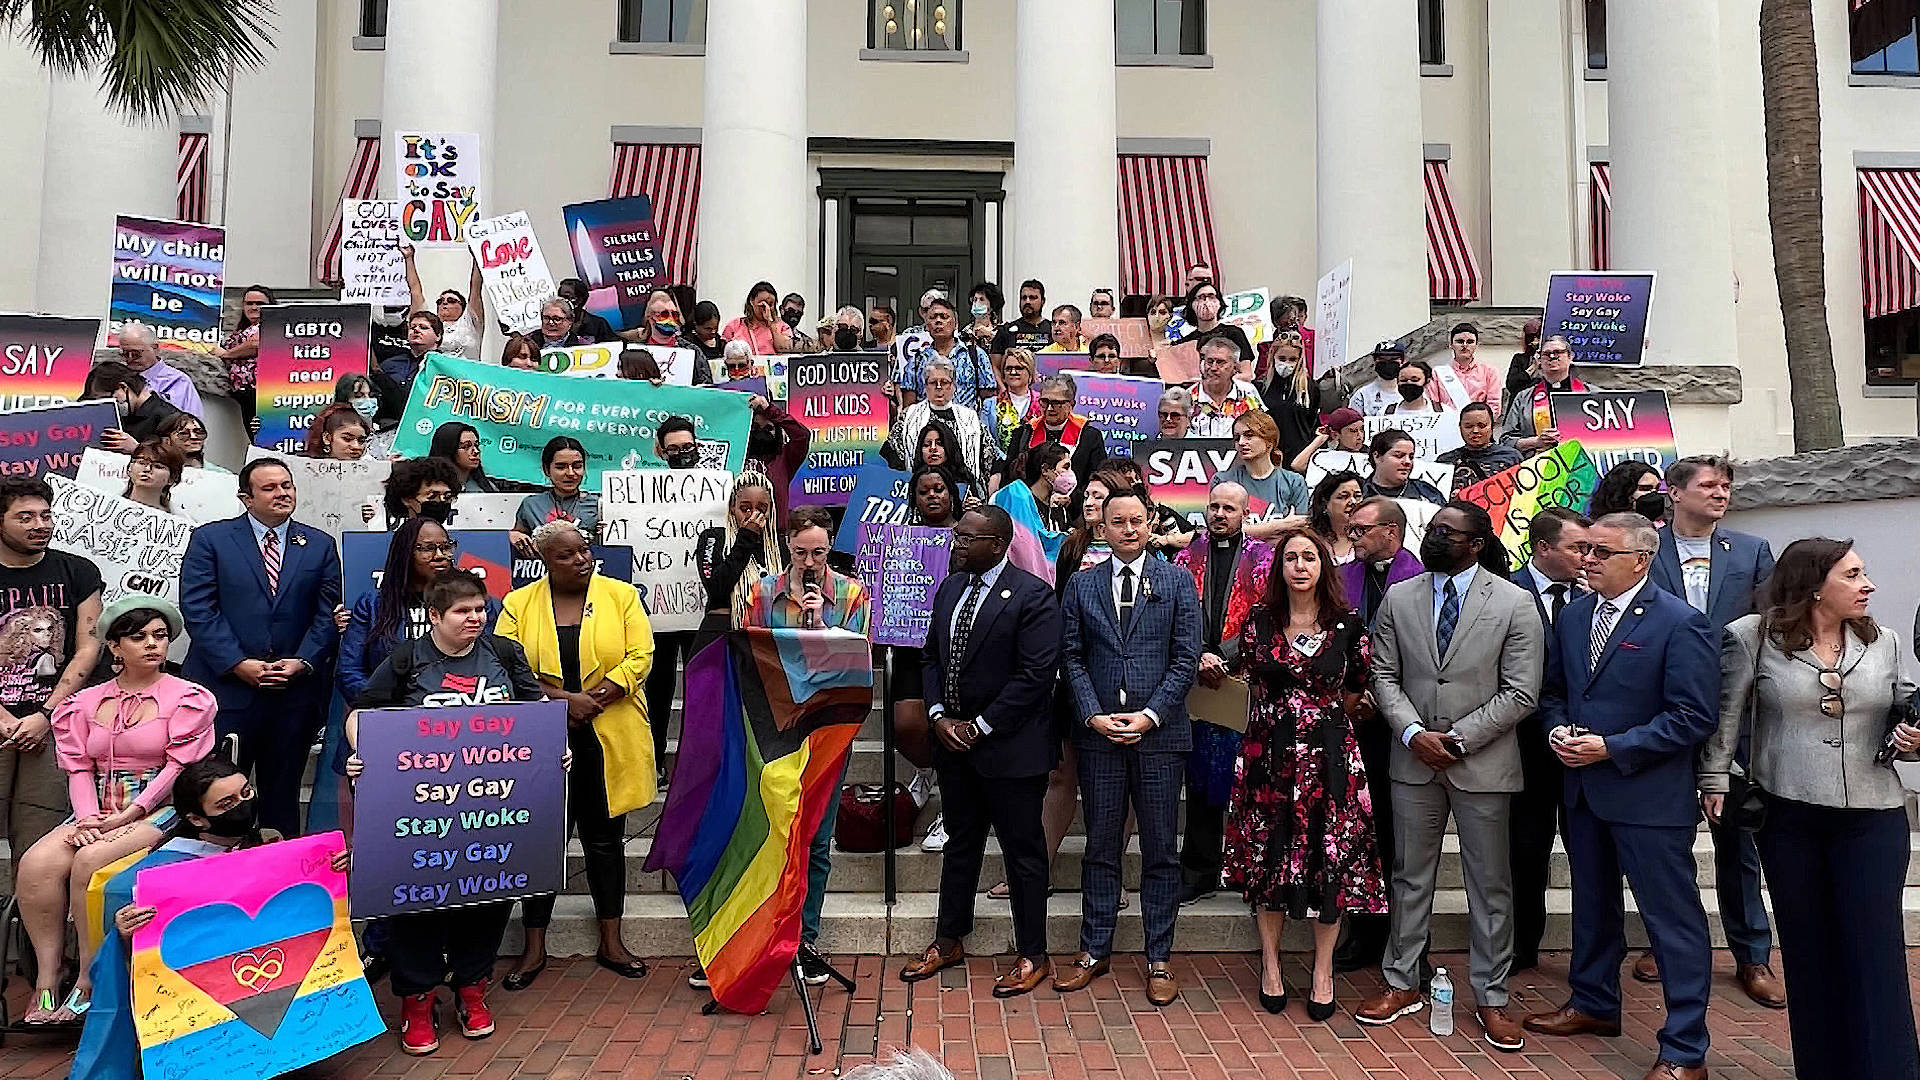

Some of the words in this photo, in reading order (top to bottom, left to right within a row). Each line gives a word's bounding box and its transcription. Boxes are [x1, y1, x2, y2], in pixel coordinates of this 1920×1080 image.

[402, 135, 458, 160] It's
[405, 161, 457, 176] OK
[405, 179, 429, 197] to
[433, 181, 476, 206] Say
[352, 219, 399, 231] LOVES
[350, 230, 400, 242] ALL
[602, 230, 651, 247] SILENCE
[116, 232, 157, 258] My
[162, 239, 225, 261] child
[480, 236, 534, 269] Love
[356, 252, 387, 263] NOT
[610, 248, 654, 266] KILLS
[119, 263, 168, 283] will
[174, 271, 218, 288] not
[500, 262, 527, 279] not
[616, 266, 656, 281] TRANS
[151, 291, 184, 312] be
[346, 286, 393, 298] WHITE
[1565, 291, 1593, 304] Stay
[1595, 291, 1632, 303] Woke
[1570, 305, 1594, 318] Say
[1595, 305, 1621, 320] Gay
[284, 321, 343, 338] LGBTQ
[1560, 320, 1589, 333] Stay
[1590, 320, 1628, 333] Woke
[1567, 334, 1590, 346] Say
[1591, 336, 1616, 348] Gay
[1, 343, 64, 377] SAY
[293, 344, 332, 359] kids
[1587, 350, 1623, 361] Woke
[289, 366, 333, 383] need
[796, 363, 827, 386] GOD
[830, 361, 879, 384] LOVES
[272, 391, 337, 409] suppor
[424, 375, 551, 429] PRISM
[554, 400, 586, 415] FOR
[591, 403, 641, 420] EVERY
[804, 394, 830, 417] ALL
[1079, 395, 1108, 409] Stay
[1111, 397, 1148, 411] Woke
[1088, 409, 1113, 424] Say
[1114, 411, 1140, 427] Gay
[1581, 397, 1637, 432] SAY
[46, 422, 93, 444] Gay
[549, 415, 580, 431] FOR
[586, 419, 658, 440] EVERYO
[824, 426, 855, 443] JUST
[857, 425, 879, 441] THE
[1110, 428, 1149, 442] Woke
[0, 457, 40, 478] tay
[808, 449, 865, 469] STRAIGHT
[1147, 449, 1239, 486] SAY
[681, 474, 729, 504] GAY
[803, 475, 837, 494] WHITE
[1466, 447, 1588, 513] SCHOOL
[1504, 507, 1533, 536] IS
[1535, 478, 1589, 511] FOR
[52, 511, 139, 565] RASE
[606, 518, 629, 542] AT
[865, 525, 885, 544] We
[859, 543, 881, 557] ALL
[857, 559, 880, 573] ALL
[0, 583, 70, 614] PAUL
[416, 715, 463, 739] Say
[468, 712, 517, 736] Gay
[397, 750, 456, 773] Stay
[461, 742, 532, 766] Woke
[415, 782, 462, 805] Say
[467, 776, 516, 800] Gay
[394, 816, 454, 839] Stay
[459, 806, 531, 830] Woke
[412, 848, 460, 871] Say
[465, 841, 514, 864] Gay
[392, 881, 452, 906] Stay
[457, 870, 529, 897] Woke
